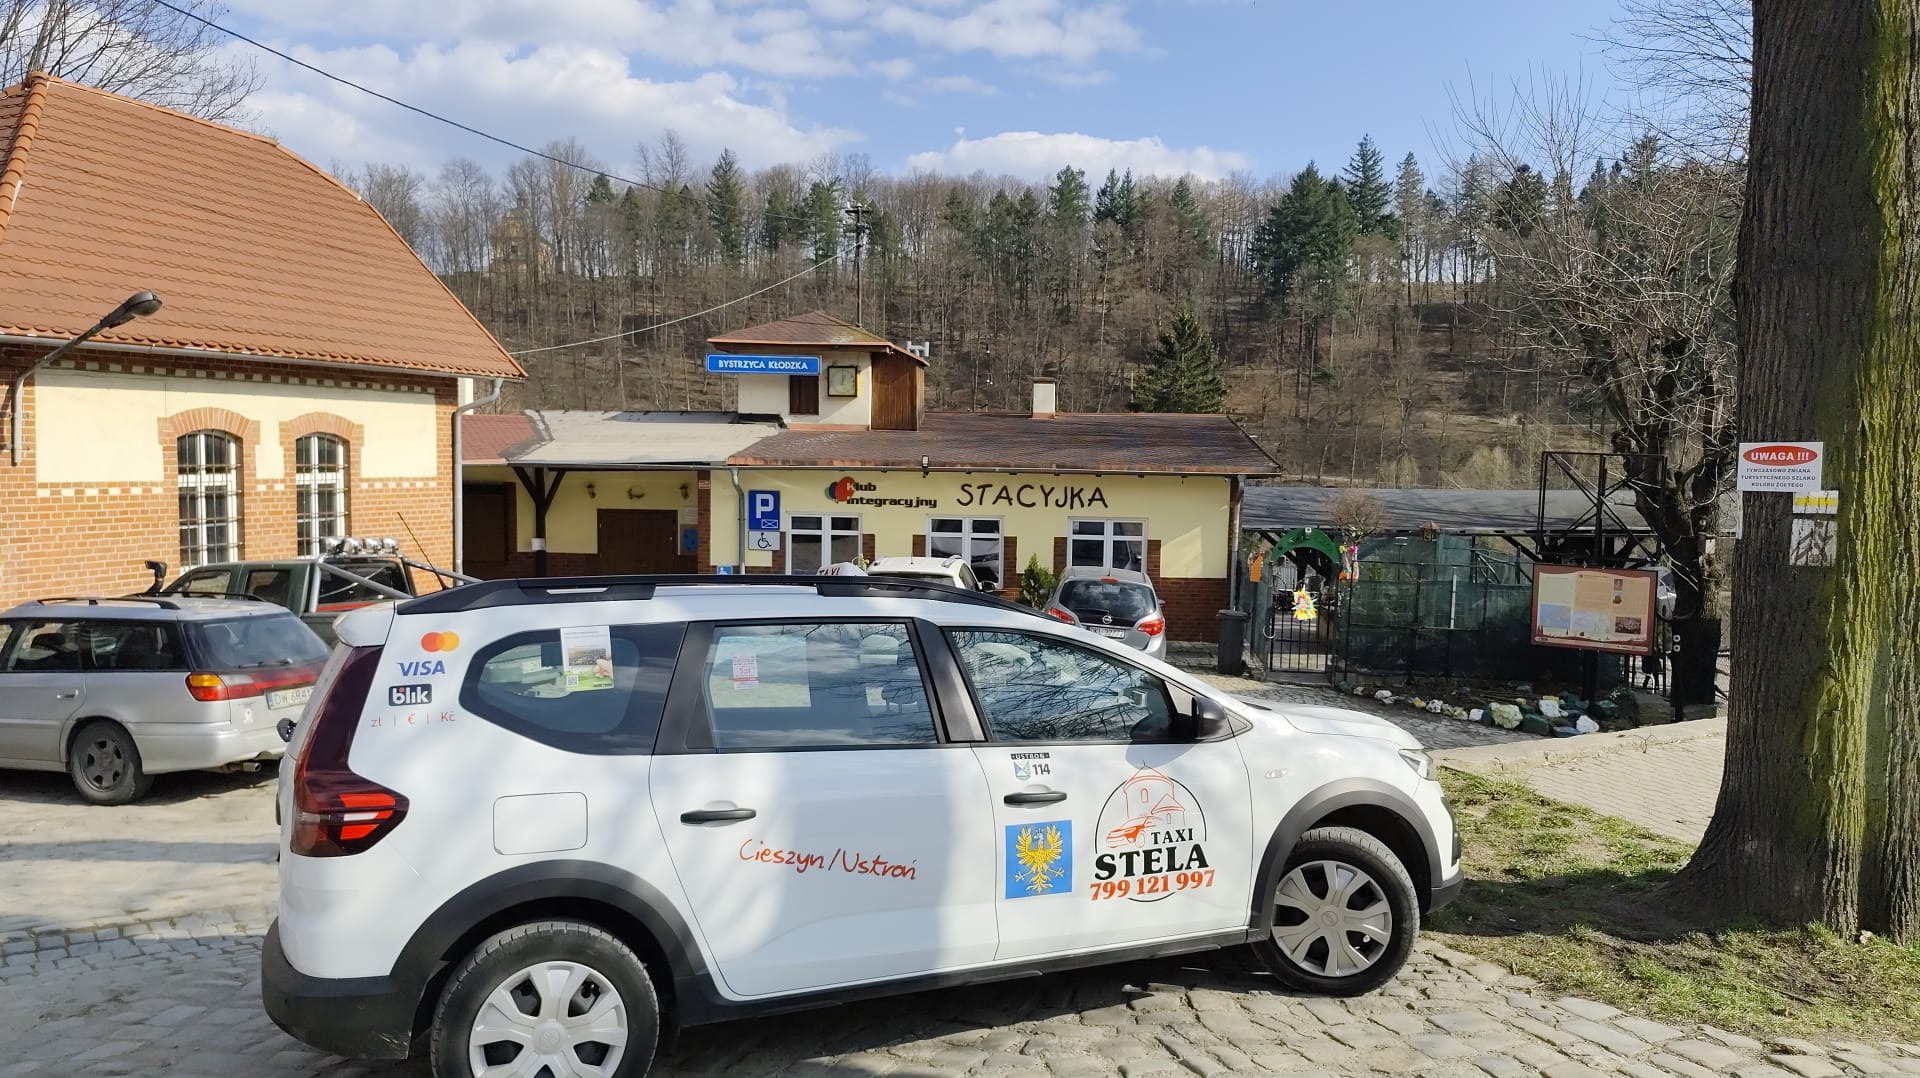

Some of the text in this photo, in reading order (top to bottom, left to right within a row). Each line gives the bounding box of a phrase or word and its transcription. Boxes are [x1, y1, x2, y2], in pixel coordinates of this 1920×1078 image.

[718, 359, 808, 370] BYSTRZYCA KŁODZKA
[1750, 452, 1809, 461] UWAGA !!!
[846, 482, 877, 492] Klub
[956, 484, 1108, 510] STACYJKA
[755, 493, 775, 519] P
[396, 660, 446, 677] VISA
[392, 686, 429, 704] blik
[1032, 763, 1051, 775] 114
[1151, 828, 1193, 845] TAXI
[1094, 843, 1209, 880] STELA
[1090, 869, 1216, 901] 799 121 997
